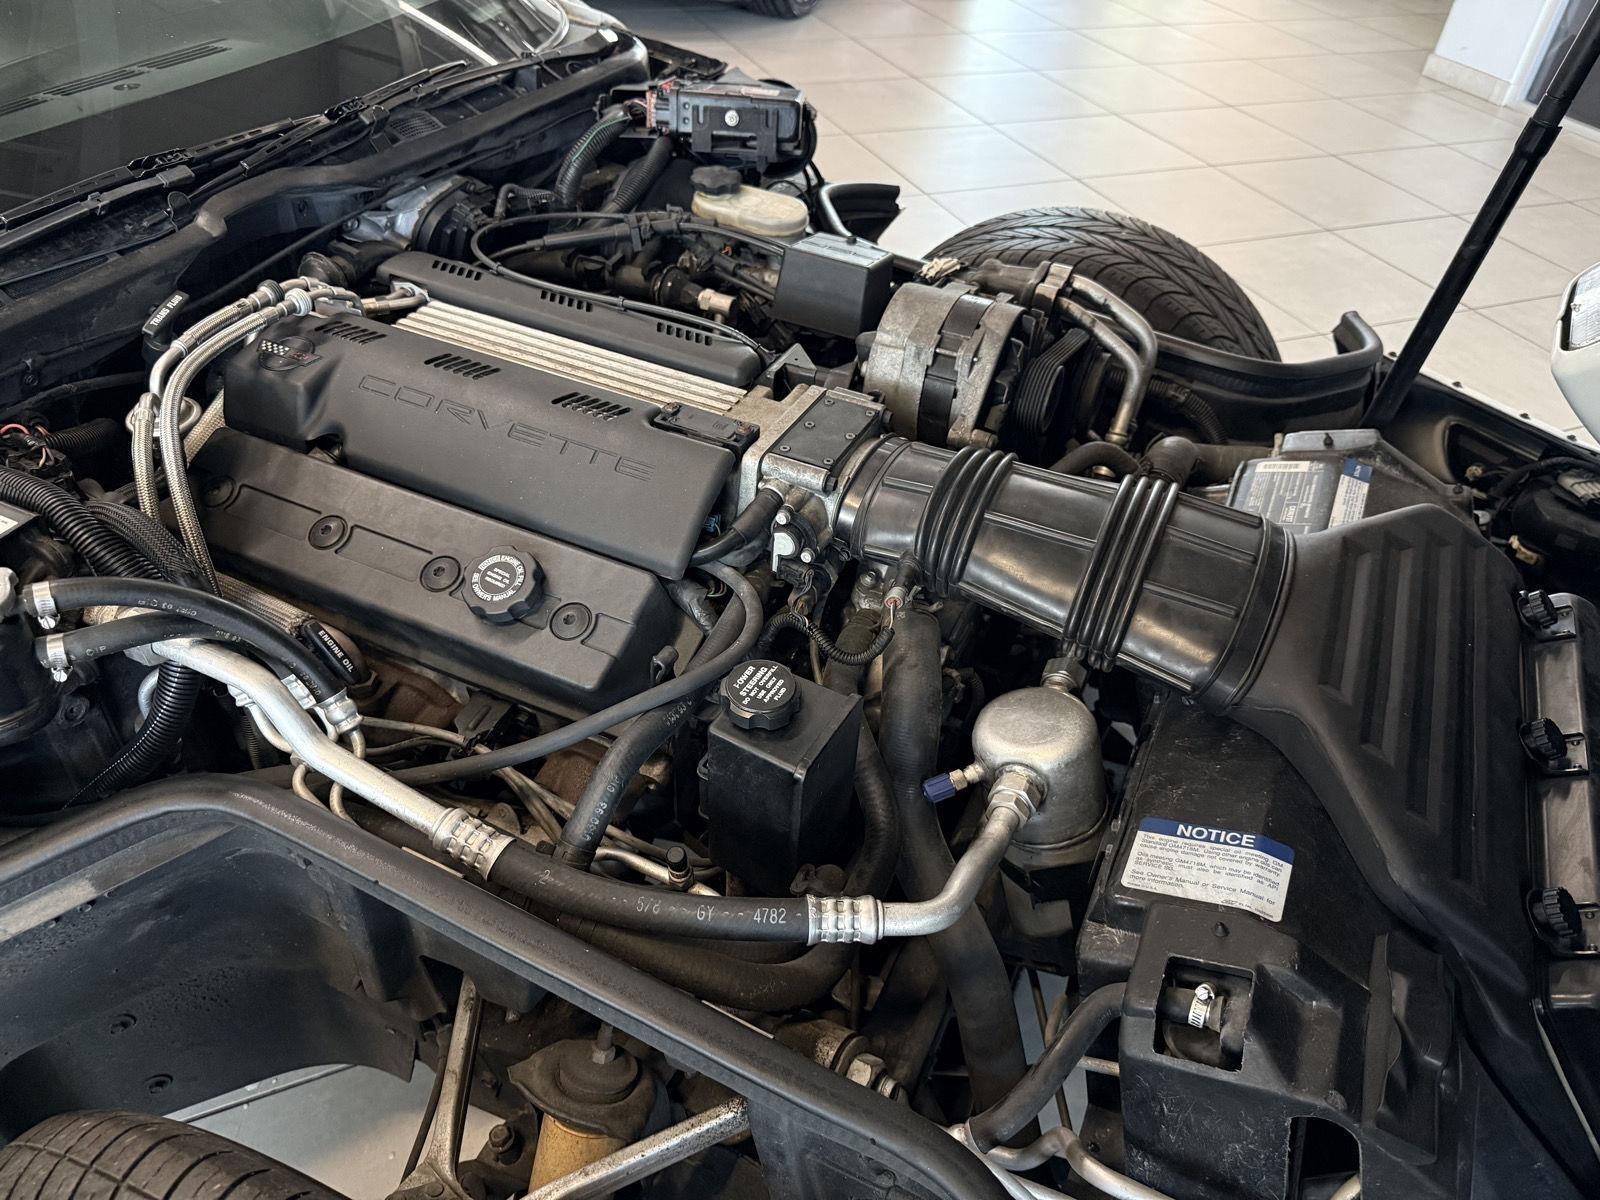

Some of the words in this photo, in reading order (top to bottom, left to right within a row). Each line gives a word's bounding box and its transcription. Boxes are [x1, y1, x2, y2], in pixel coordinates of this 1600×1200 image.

[150, 306, 170, 327] TRANS
[167, 294, 184, 313] FLUID
[358, 374, 656, 482] CORVETTE
[493, 590, 517, 601] MANUAL
[317, 629, 344, 659] ENGINE
[341, 657, 353, 672] OIL
[739, 666, 768, 696] STEERING
[742, 697, 751, 705] DO
[749, 687, 759, 697] NOT
[758, 665, 778, 686] OVERFILL
[763, 679, 784, 703] APPROVED
[765, 676, 777, 689] ONLY
[773, 687, 787, 701] FLUID
[1177, 824, 1256, 847] NOTICE
[1133, 859, 1162, 869] SERVICE
[1180, 849, 1205, 859] damage
[1218, 855, 1243, 864] covered
[1202, 848, 1221, 856] Using
[1238, 854, 1259, 863] engine
[1208, 844, 1231, 854] special
[1244, 851, 1269, 863] meeting
[1128, 873, 1146, 881] more
[1145, 871, 1173, 881] Owner's
[1174, 876, 1200, 886] Manual
[1210, 882, 1237, 892] Service
[1239, 887, 1265, 901] Manual
[1208, 863, 1227, 871] which
[1227, 866, 1242, 874] may
[1252, 871, 1280, 887] identified
[1224, 871, 1253, 881] identified
[696, 901, 715, 921] GY
[753, 906, 787, 925] 4782
